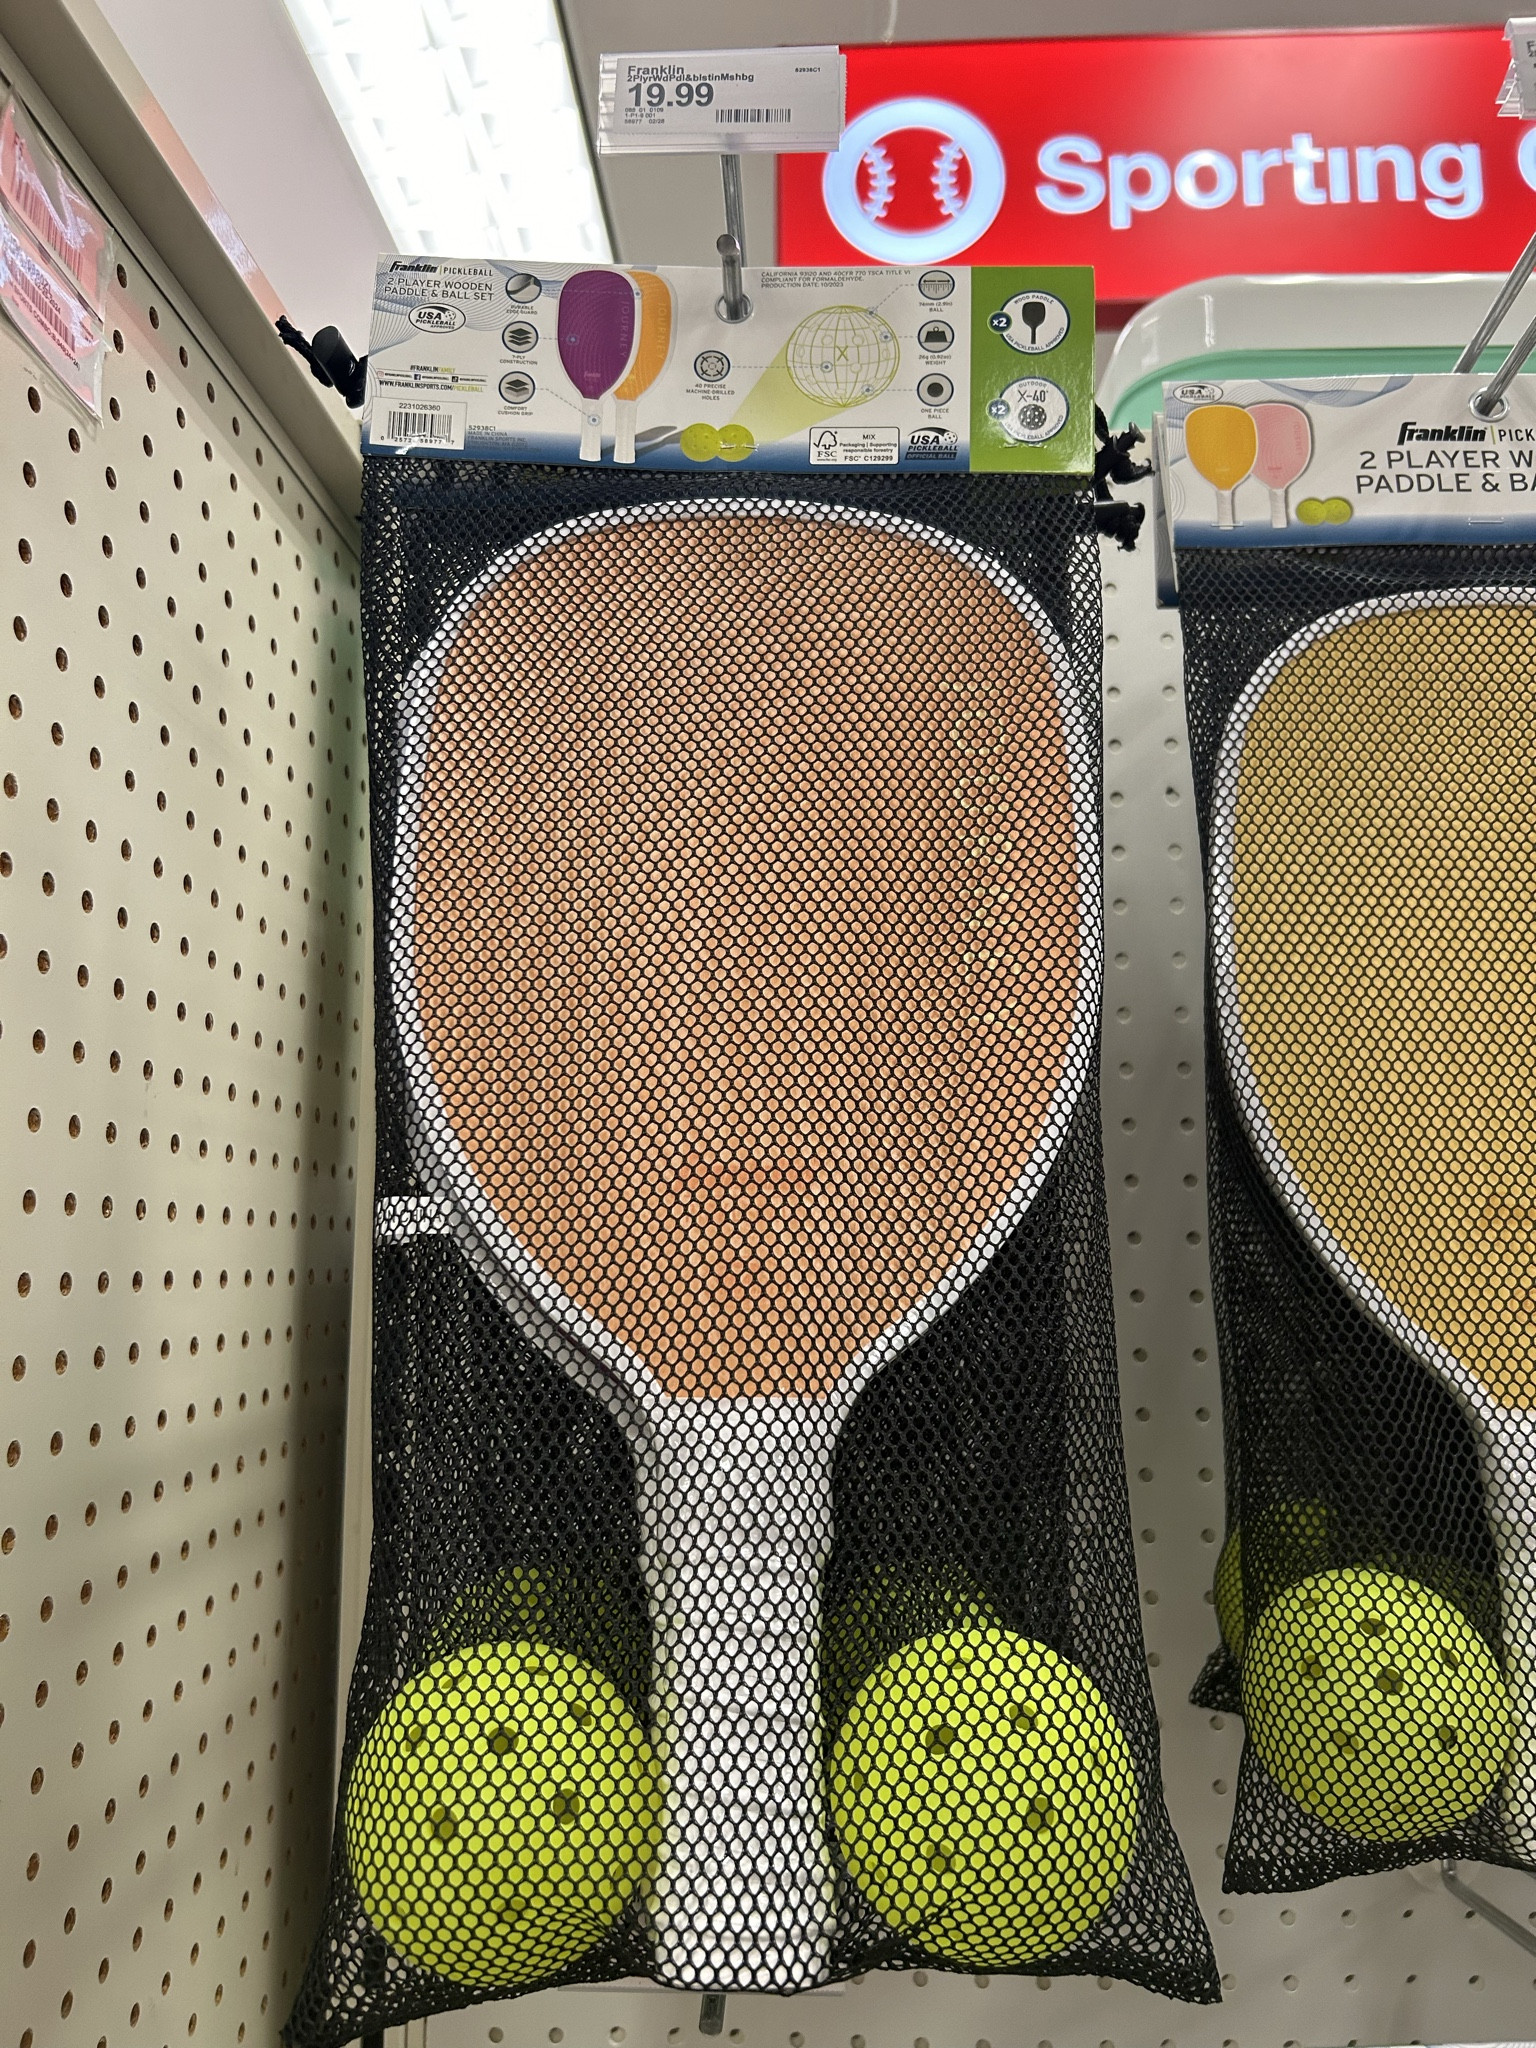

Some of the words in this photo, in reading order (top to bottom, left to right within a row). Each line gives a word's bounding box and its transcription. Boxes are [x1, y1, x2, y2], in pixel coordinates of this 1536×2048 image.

[628, 65, 684, 75] Franklin
[628, 82, 714, 107] 19.99
[1035, 133, 1484, 229] Sporting
[443, 266, 494, 276] PICKLEBALL
[387, 277, 394, 286] 2
[397, 278, 441, 289] PLAYER
[444, 281, 493, 292] WOODEN
[384, 286, 429, 297] PADDLE
[430, 289, 438, 298] &
[441, 290, 470, 300] BALL
[473, 292, 494, 301] SET
[417, 311, 442, 320] USA
[992, 317, 1007, 327] x2
[991, 404, 1006, 415] x2
[910, 435, 940, 445] USA
[1360, 451, 1376, 470] 2
[1386, 450, 1500, 469] PLAYER
[1356, 473, 1472, 494] PADDLE
[1481, 472, 1501, 492] &
